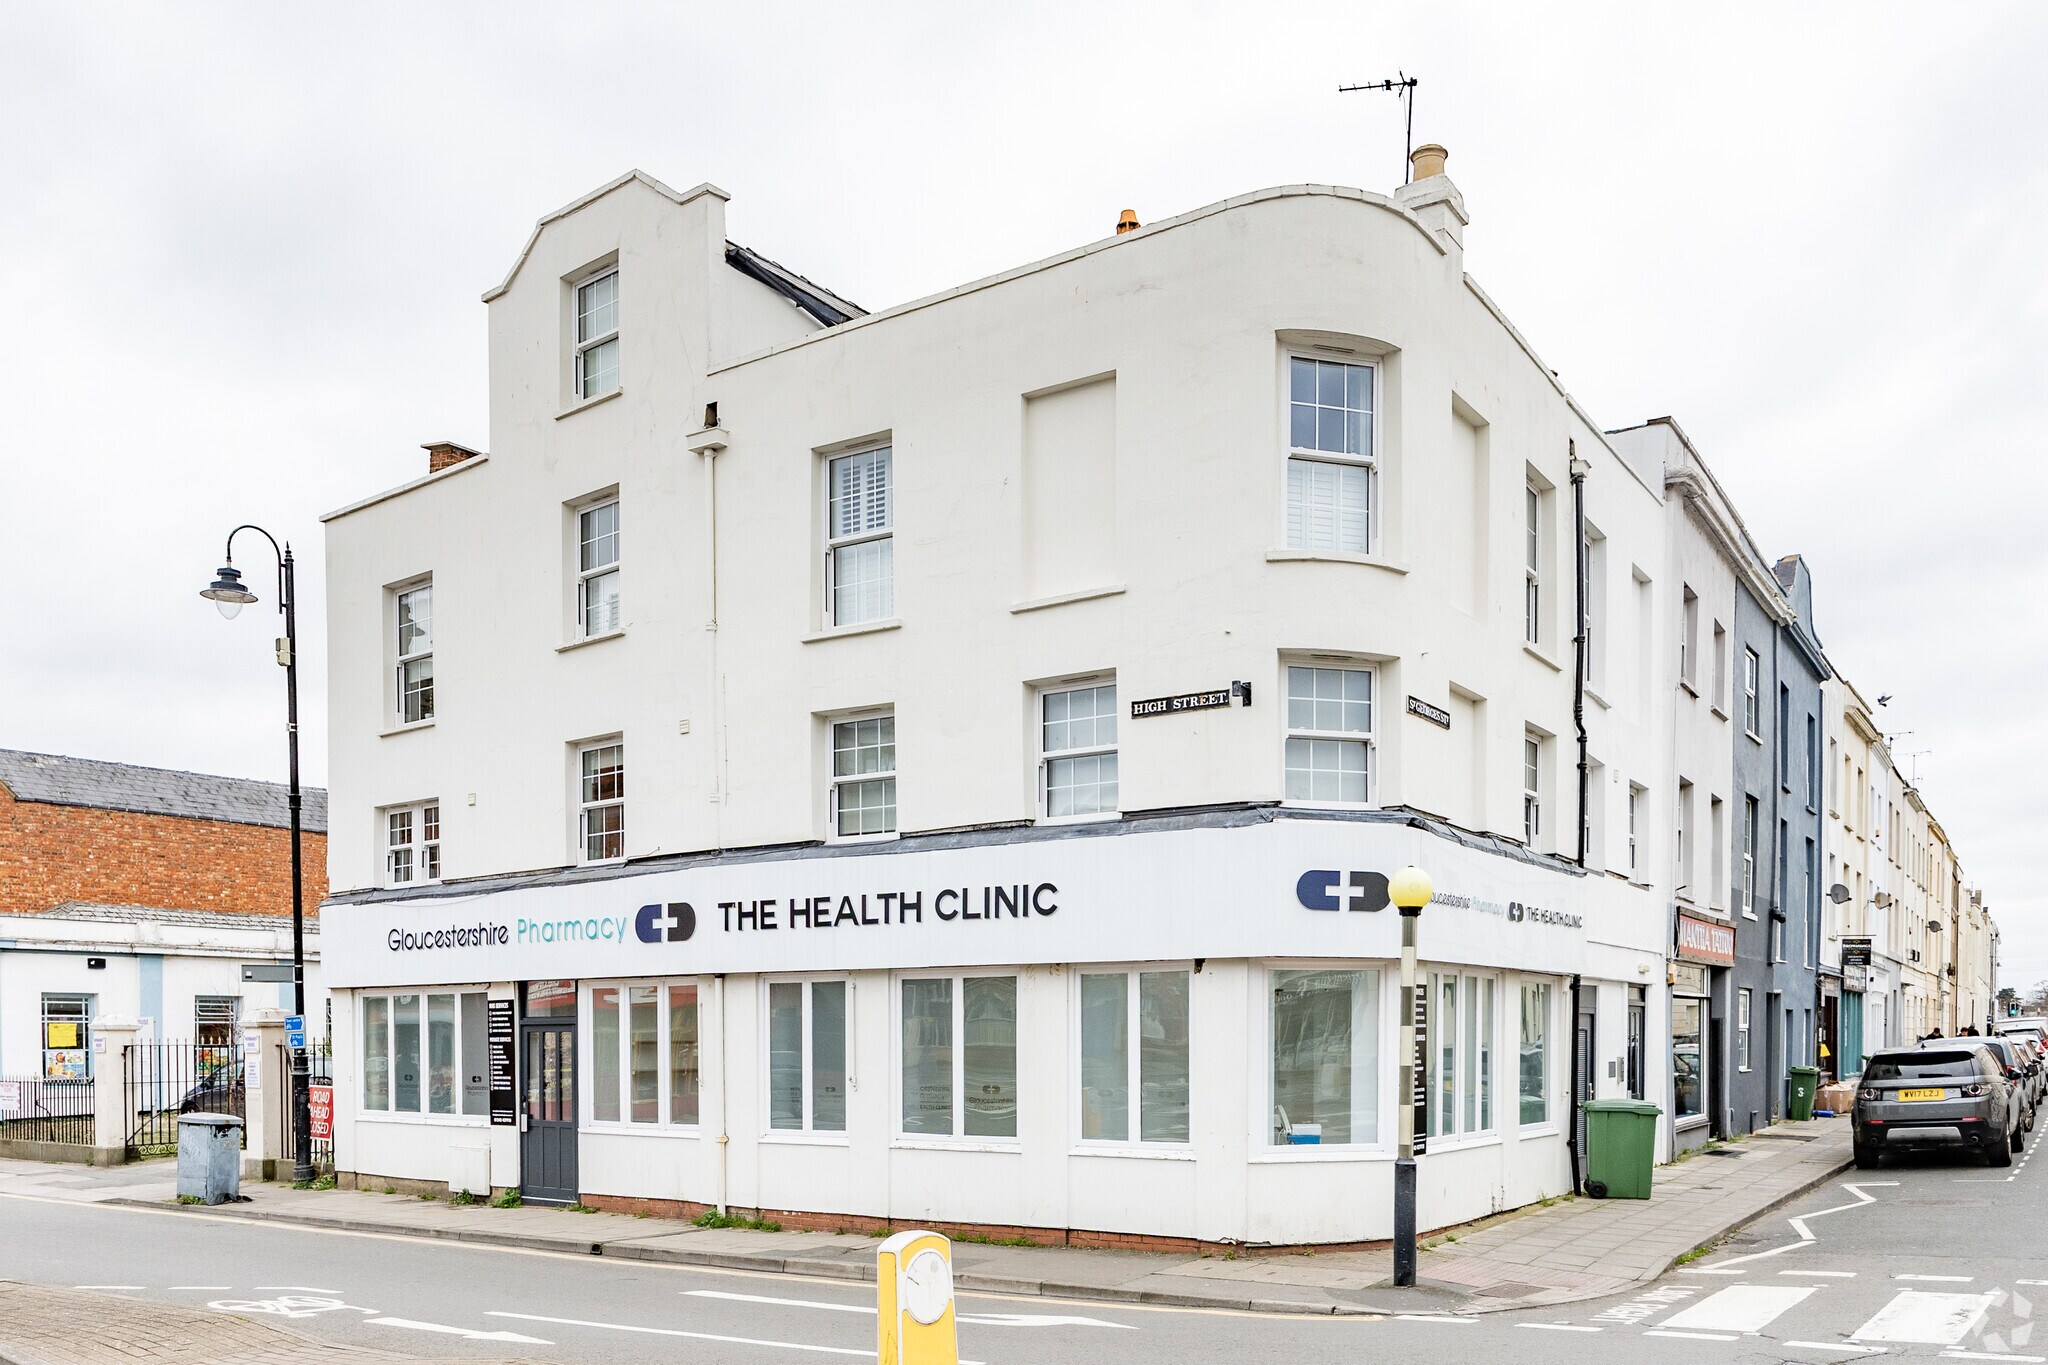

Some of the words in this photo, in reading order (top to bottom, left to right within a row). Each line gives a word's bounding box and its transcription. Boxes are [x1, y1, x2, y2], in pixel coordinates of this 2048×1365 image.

[1133, 701, 1167, 714] HIGH
[718, 899, 778, 931] THE
[789, 891, 922, 929] HEALTH
[935, 883, 1058, 921] CLINIC
[1430, 891, 1470, 909] oucestershire
[1526, 906, 1539, 921] THE
[1541, 909, 1563, 925] HEALTH
[1563, 914, 1582, 929] CLINIC
[388, 922, 509, 951] Gloucestershire
[517, 917, 627, 943] Pharmacy
[313, 1091, 330, 1104] ROAD
[1798, 1087, 1804, 1097] 3
